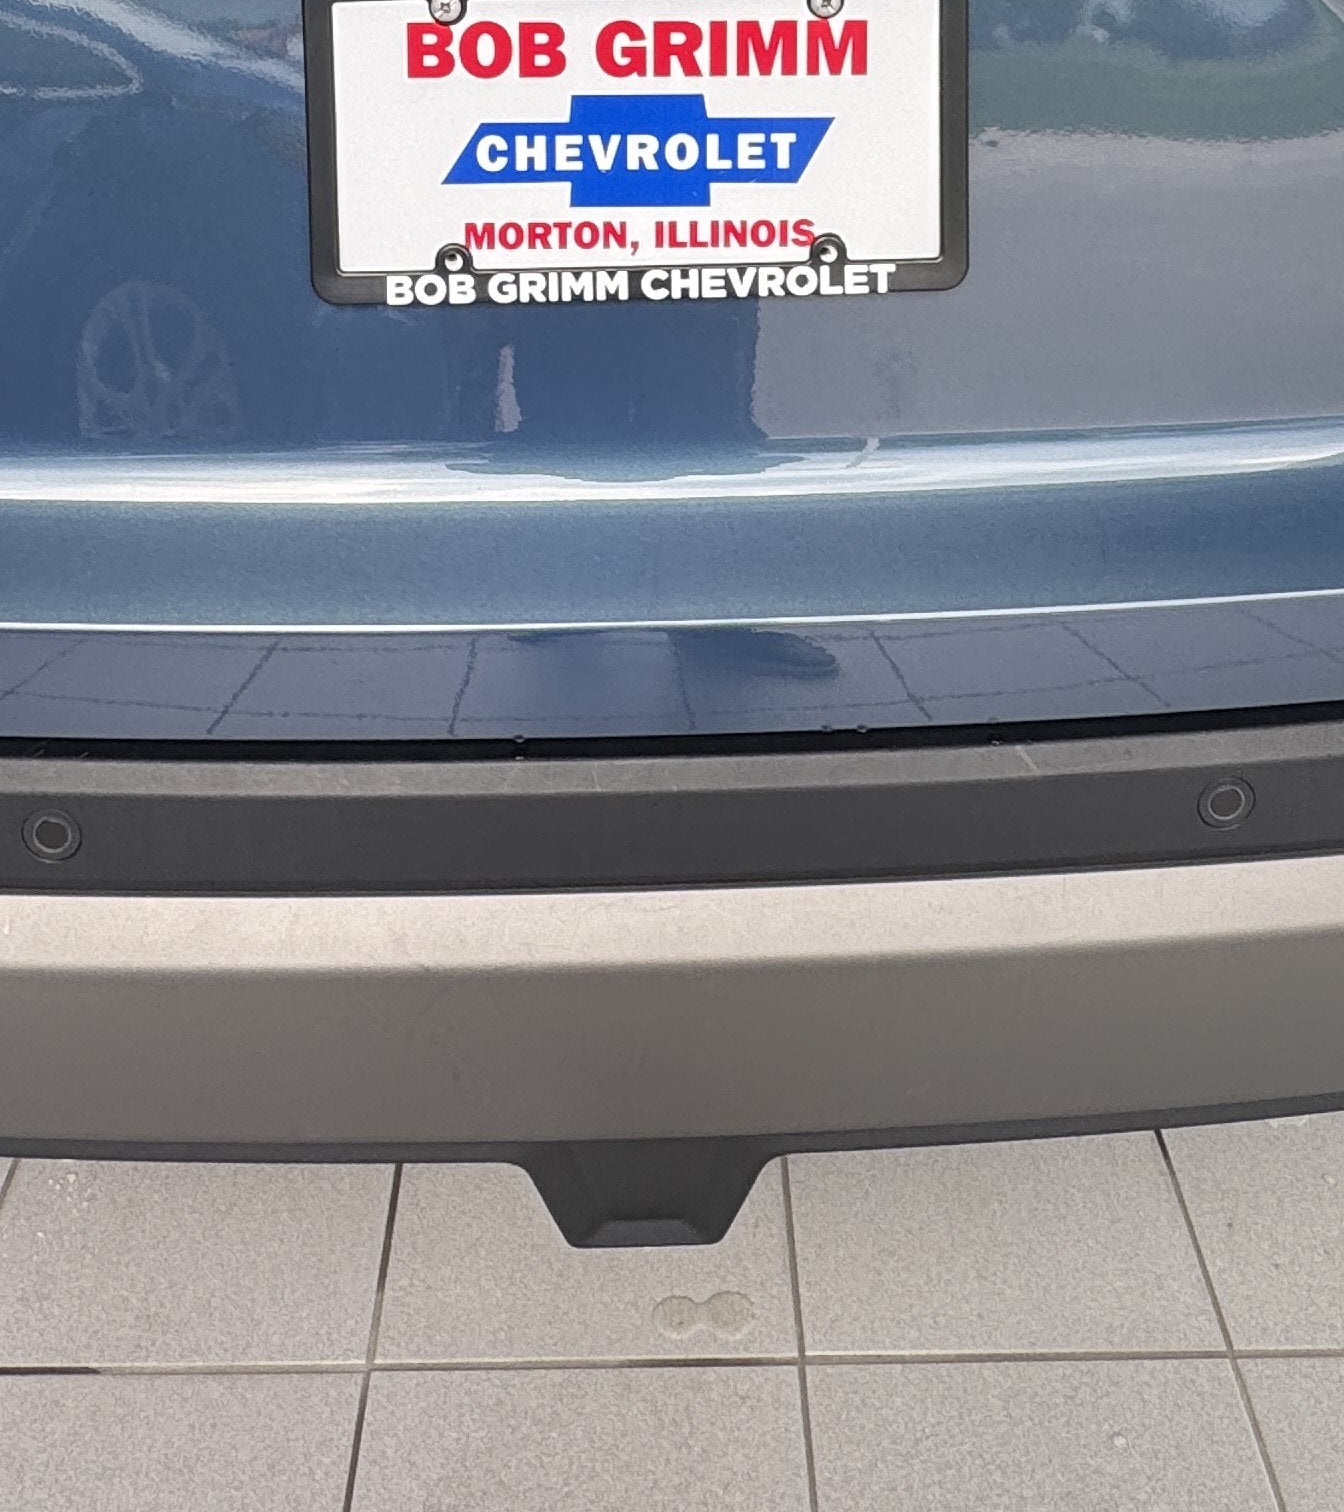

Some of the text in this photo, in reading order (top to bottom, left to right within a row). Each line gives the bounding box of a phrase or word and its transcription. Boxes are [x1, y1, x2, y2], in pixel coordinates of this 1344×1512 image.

[406, 20, 868, 79] BOB GRIMM
[475, 132, 797, 172] CHEVROLET
[464, 218, 816, 256] MORTON, ILLINOIS
[386, 264, 896, 305] BOB GRIMM CHEVROLET
